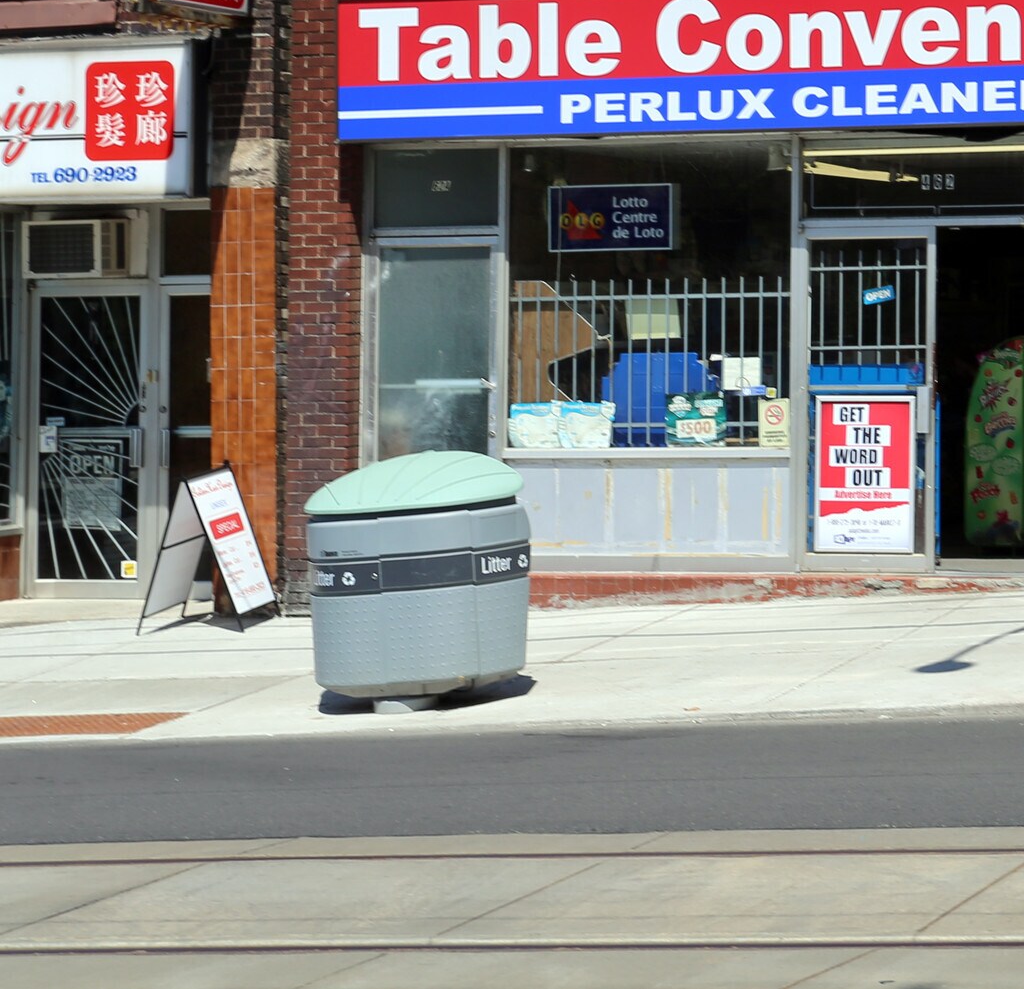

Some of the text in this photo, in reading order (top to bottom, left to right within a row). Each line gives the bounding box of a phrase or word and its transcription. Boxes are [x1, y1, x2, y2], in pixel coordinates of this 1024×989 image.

[358, 0, 623, 83] Table
[559, 87, 776, 124] PERLUX
[54, 166, 137, 183] 690-2923
[612, 196, 649, 208] Lotto
[611, 211, 658, 224] Centre
[612, 226, 664, 239] de Loto
[865, 288, 891, 302] OPEN
[839, 406, 865, 423] GET
[680, 420, 712, 436] $500
[853, 427, 881, 444] THE
[69, 454, 116, 475] OPEN
[834, 448, 878, 465] WORD
[852, 469, 882, 487] OUT
[834, 489, 893, 499] Advertise Here
[481, 556, 512, 575] Litter
